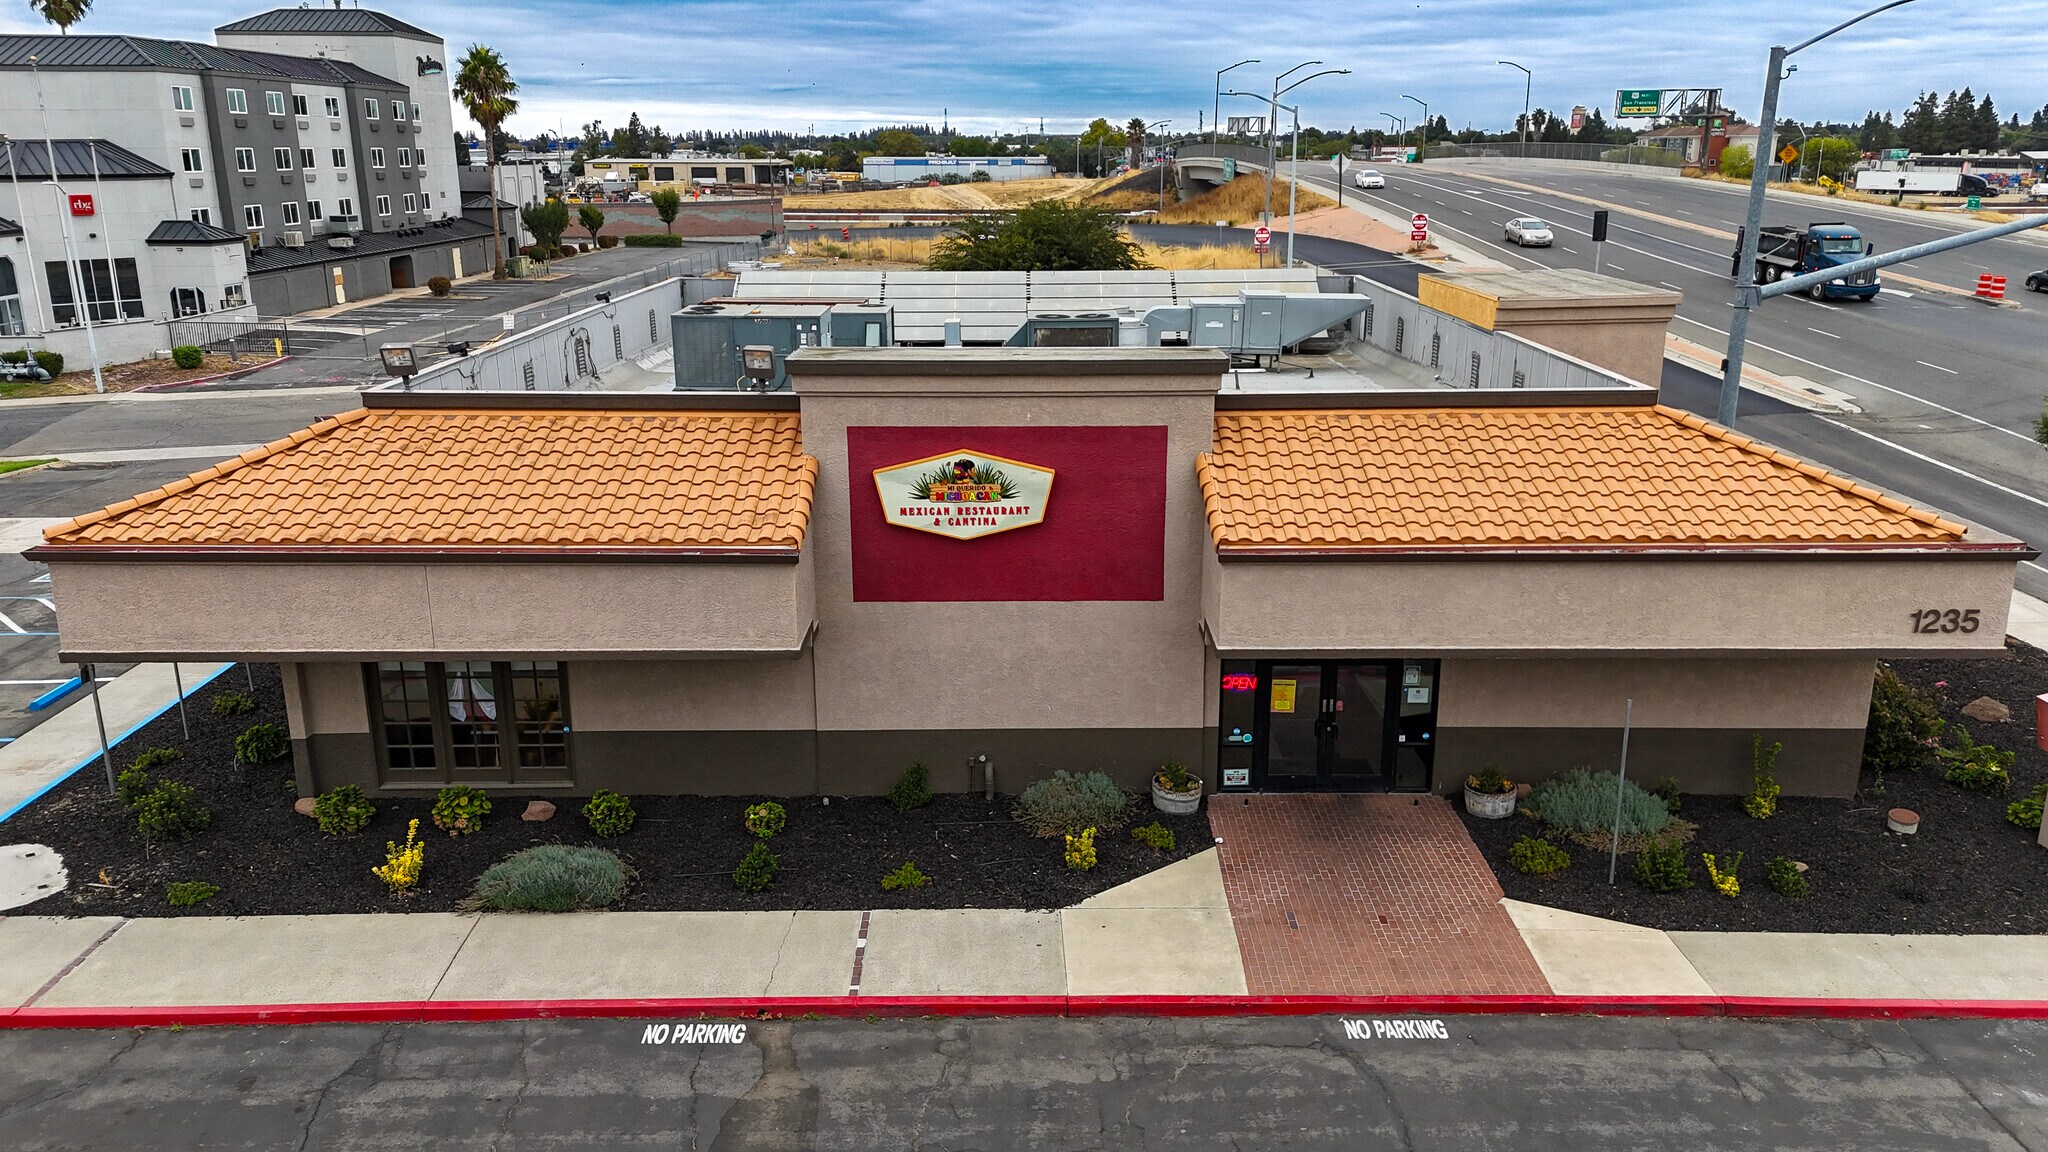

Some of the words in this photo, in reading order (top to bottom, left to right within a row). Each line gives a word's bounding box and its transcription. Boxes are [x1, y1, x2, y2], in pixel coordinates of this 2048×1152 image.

[73, 199, 92, 211] rbg
[935, 491, 998, 501] MICHOACAN
[900, 507, 950, 516] MEXICAN
[957, 506, 1030, 516] RESTAURANT
[933, 517, 941, 527] &
[948, 517, 997, 526] CANTINA
[1909, 608, 1981, 633] 1235
[1222, 676, 1258, 690] OPEN
[641, 1024, 669, 1044] NO
[671, 1024, 747, 1044] PARKING
[1342, 1019, 1371, 1039] NO
[1372, 1019, 1449, 1039] PARKING
